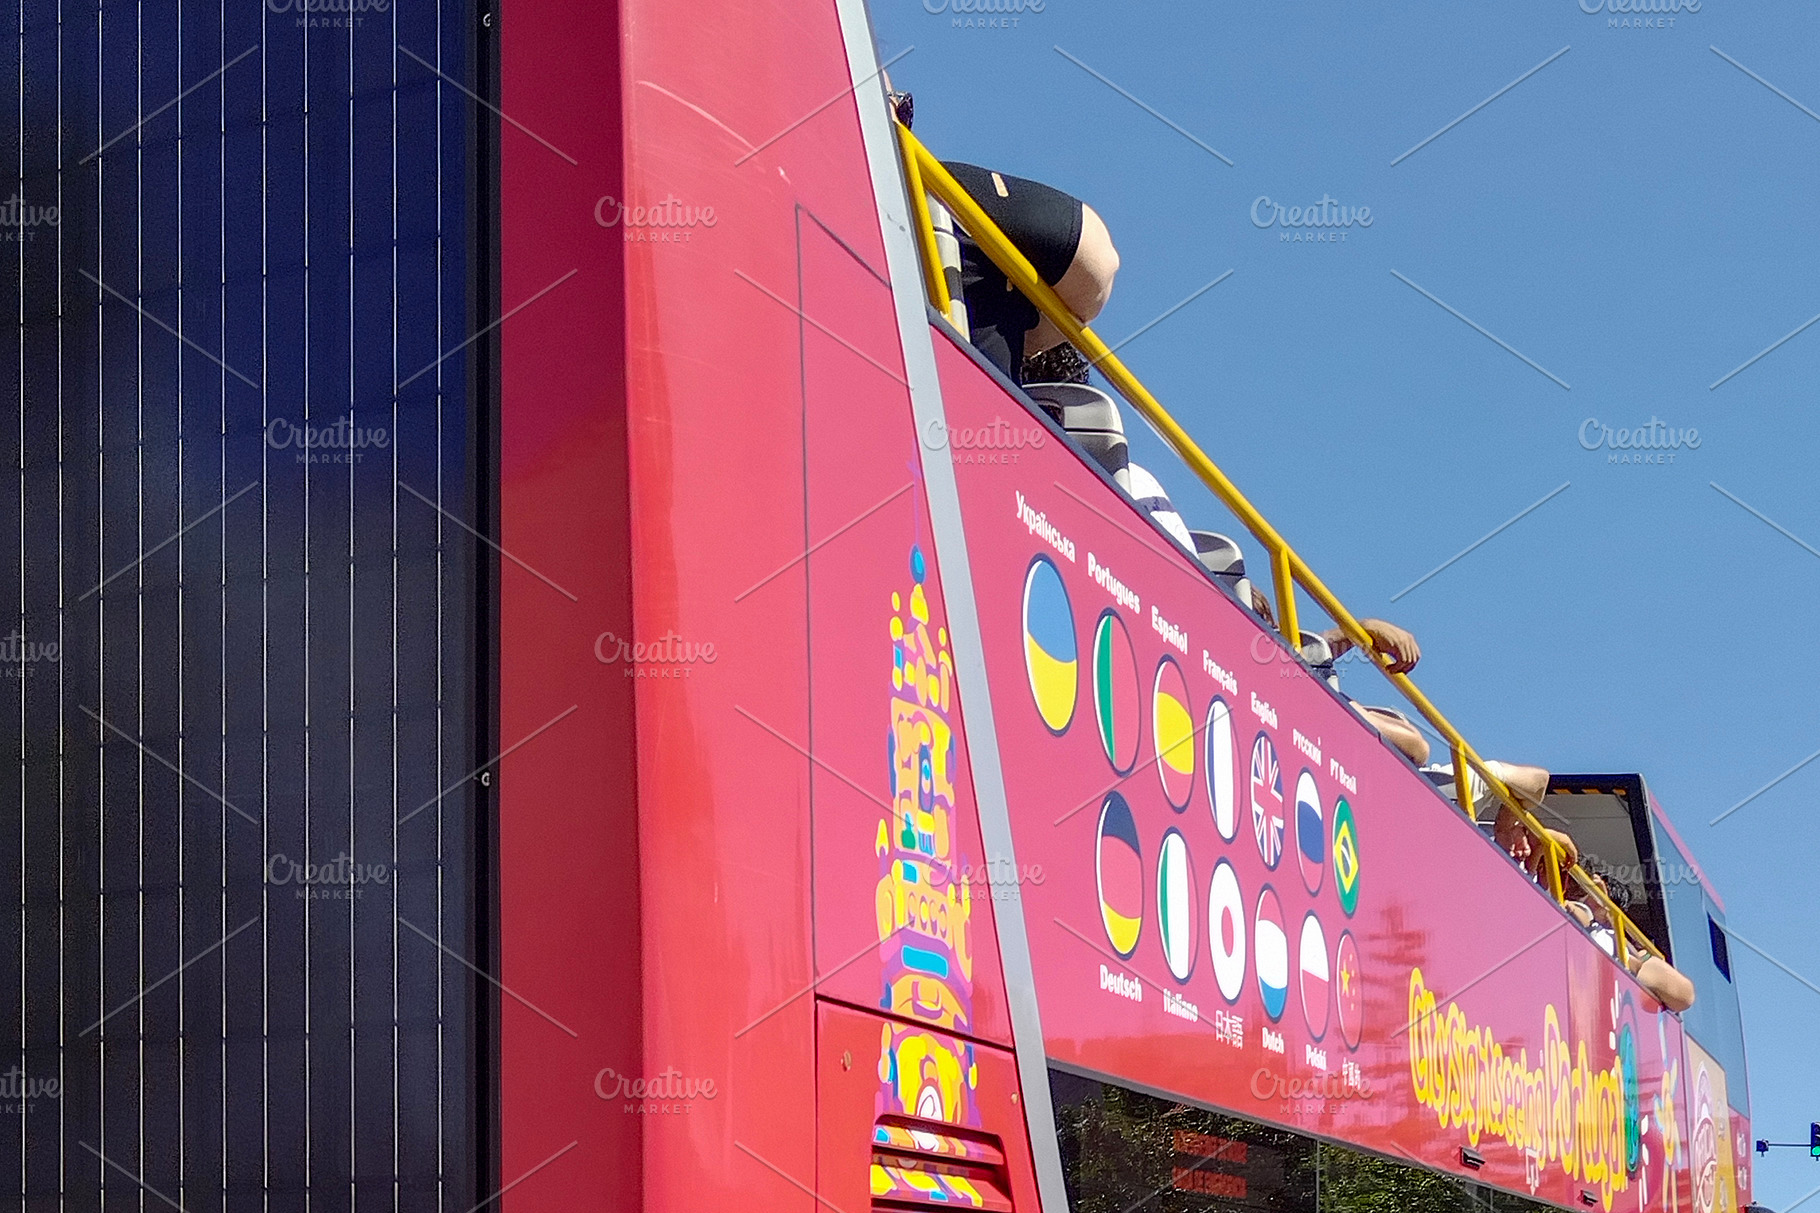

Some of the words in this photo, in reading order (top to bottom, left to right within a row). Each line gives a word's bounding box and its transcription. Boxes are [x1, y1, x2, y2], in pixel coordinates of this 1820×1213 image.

[1016, 490, 1076, 563] Українська
[1087, 552, 1141, 614] Portugues
[1151, 605, 1188, 654] Español
[1202, 649, 1238, 696] Français
[1250, 691, 1278, 730] English
[1100, 964, 1142, 1002] Deutsch
[1163, 988, 1199, 1022] Italiano
[1262, 1026, 1285, 1054] Dutch
